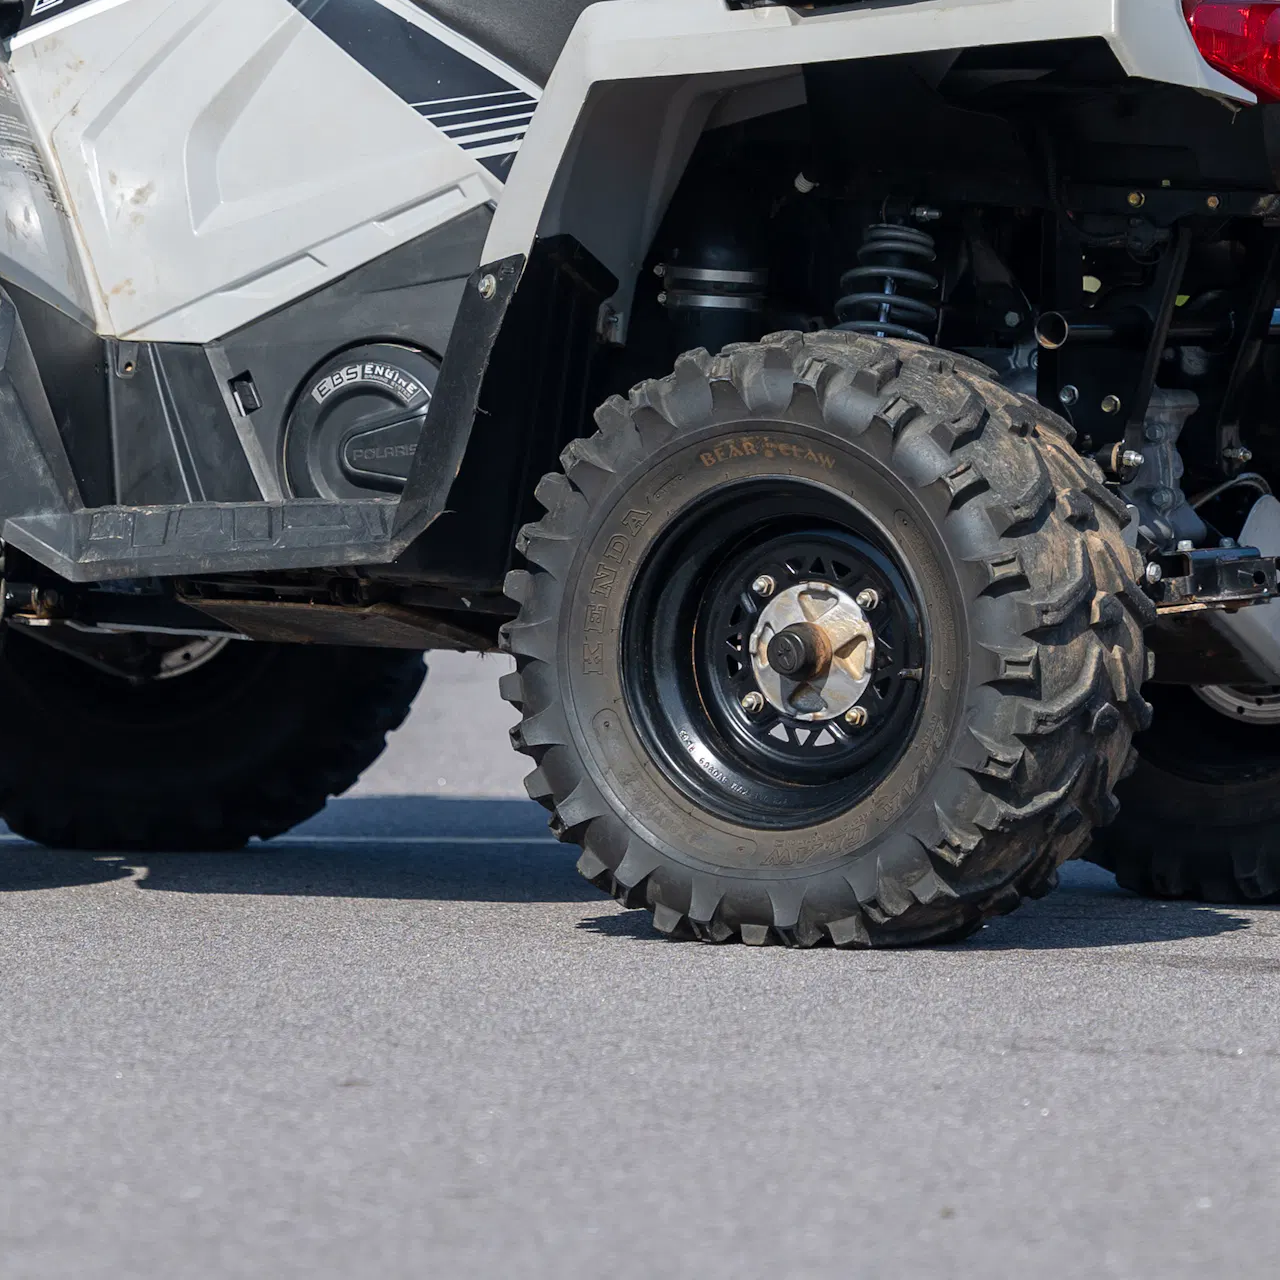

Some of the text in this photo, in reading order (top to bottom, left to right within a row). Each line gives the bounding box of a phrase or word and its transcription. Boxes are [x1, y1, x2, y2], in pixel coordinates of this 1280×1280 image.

[315, 364, 419, 398] EBS ENGINE
[352, 443, 419, 461] POLARIS
[699, 439, 758, 468] BEAR
[583, 509, 653, 676] KENDA
